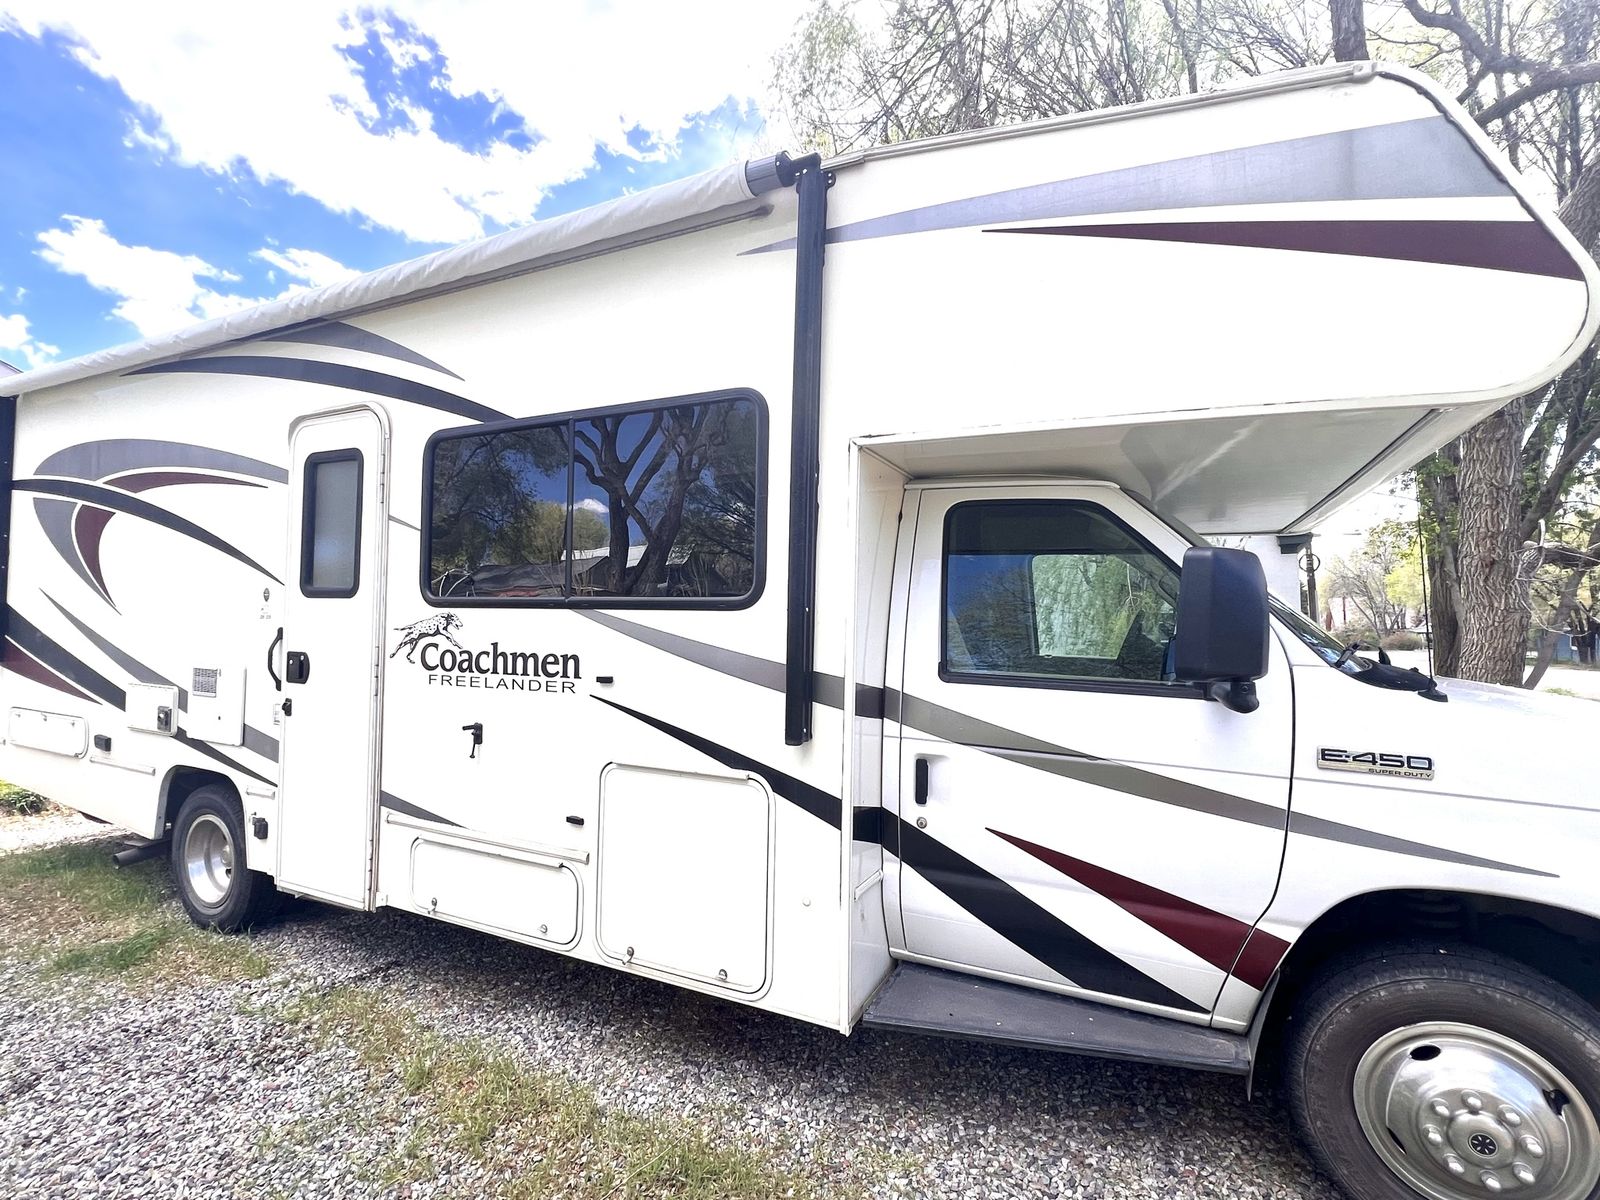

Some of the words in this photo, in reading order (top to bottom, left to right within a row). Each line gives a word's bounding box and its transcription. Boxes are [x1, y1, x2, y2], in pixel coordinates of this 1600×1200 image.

[420, 642, 582, 679] Coachmen
[428, 674, 576, 694] FREELANDER
[1320, 748, 1433, 770] E-450
[1368, 768, 1401, 776] SUPER
